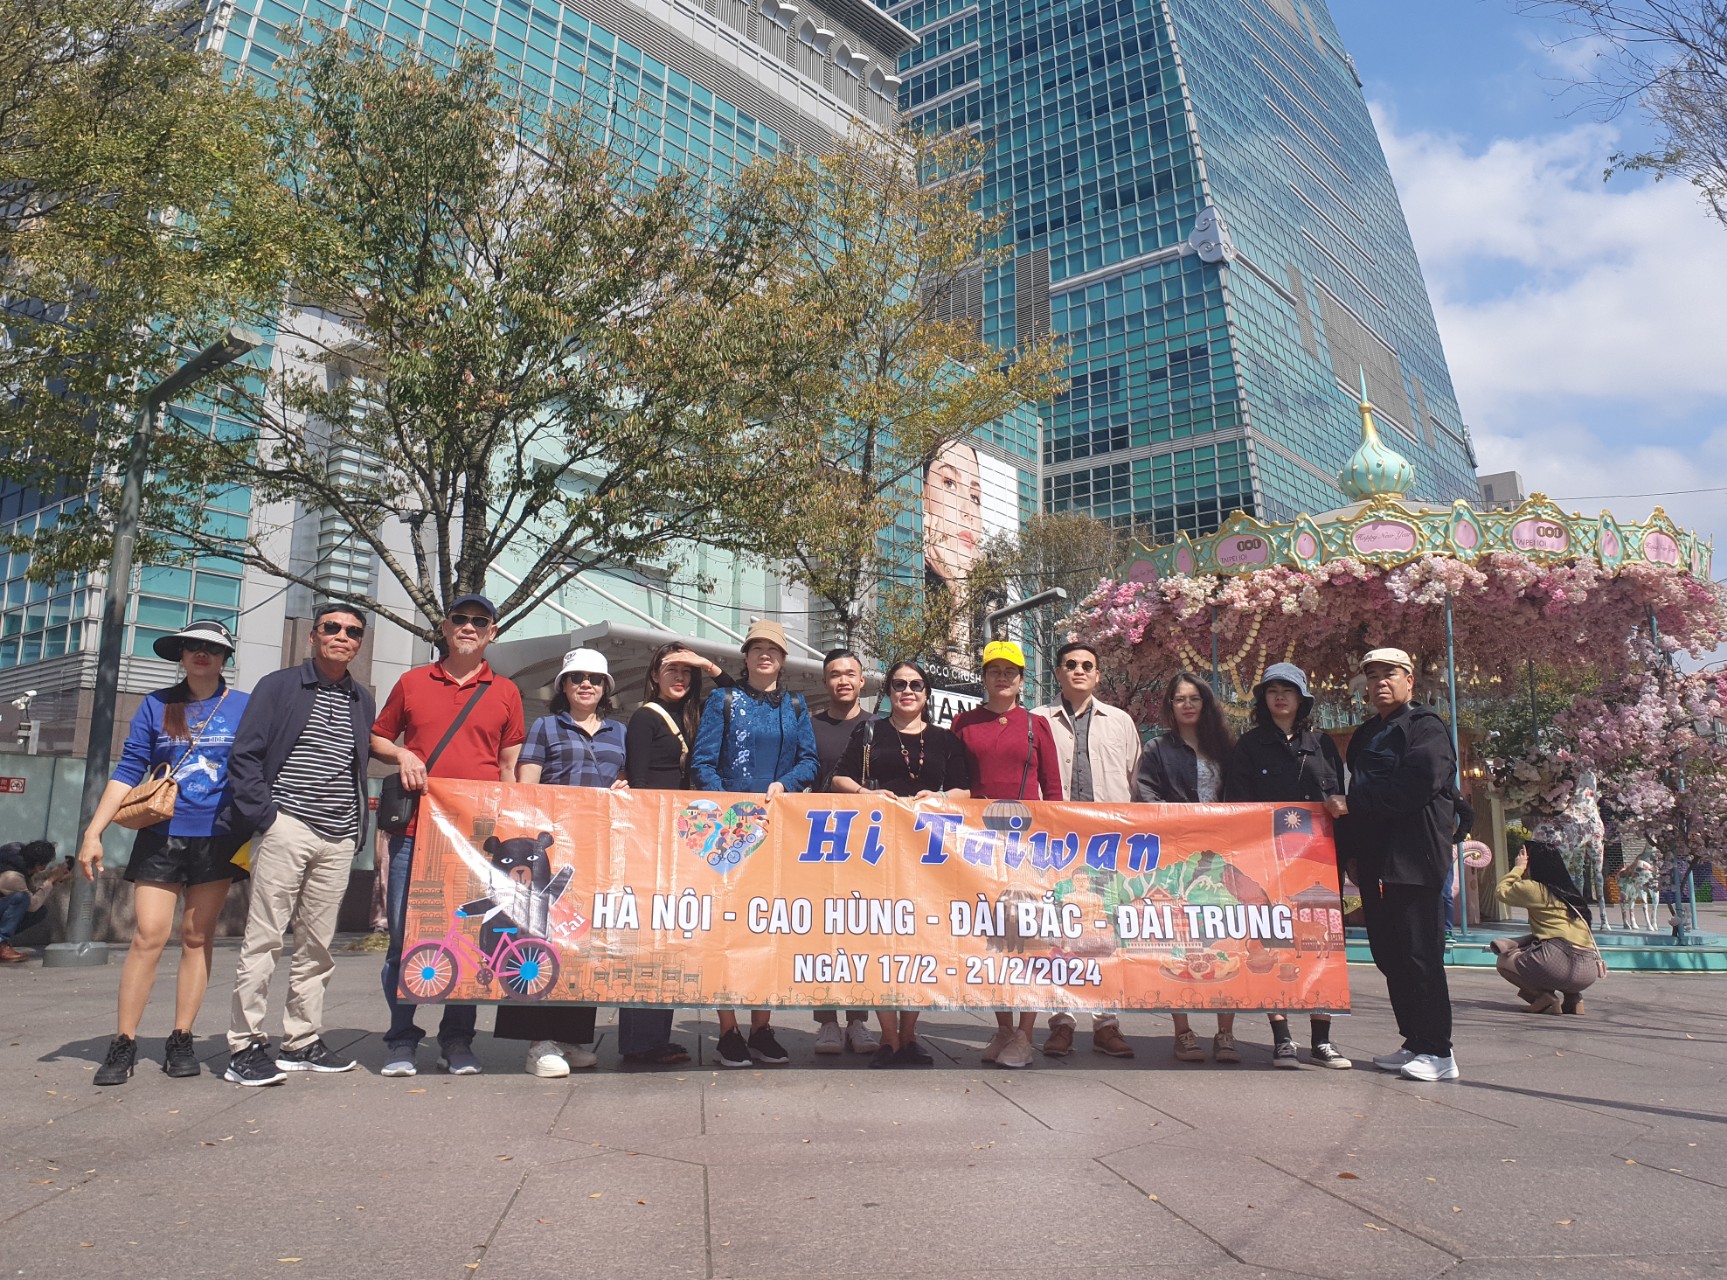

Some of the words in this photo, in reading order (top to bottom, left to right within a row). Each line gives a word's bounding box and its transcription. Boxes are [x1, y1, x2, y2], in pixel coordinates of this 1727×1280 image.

[951, 669, 982, 683] CRUSH
[798, 810, 885, 866] Hi
[914, 812, 1160, 872] Taiwan
[554, 912, 586, 937] Tai
[592, 886, 640, 930] HÀ
[651, 888, 712, 939] NỘI
[748, 896, 812, 934] CAO
[823, 891, 916, 935] HÙNG
[949, 893, 1005, 937] ĐÀI
[1018, 890, 1083, 938] BẮC
[1117, 899, 1174, 939] ĐÀI
[1183, 904, 1294, 940] TRUNG
[793, 948, 869, 983] NGÀY
[878, 954, 938, 984] 17/2
[966, 956, 1102, 986] 21/2/2024
